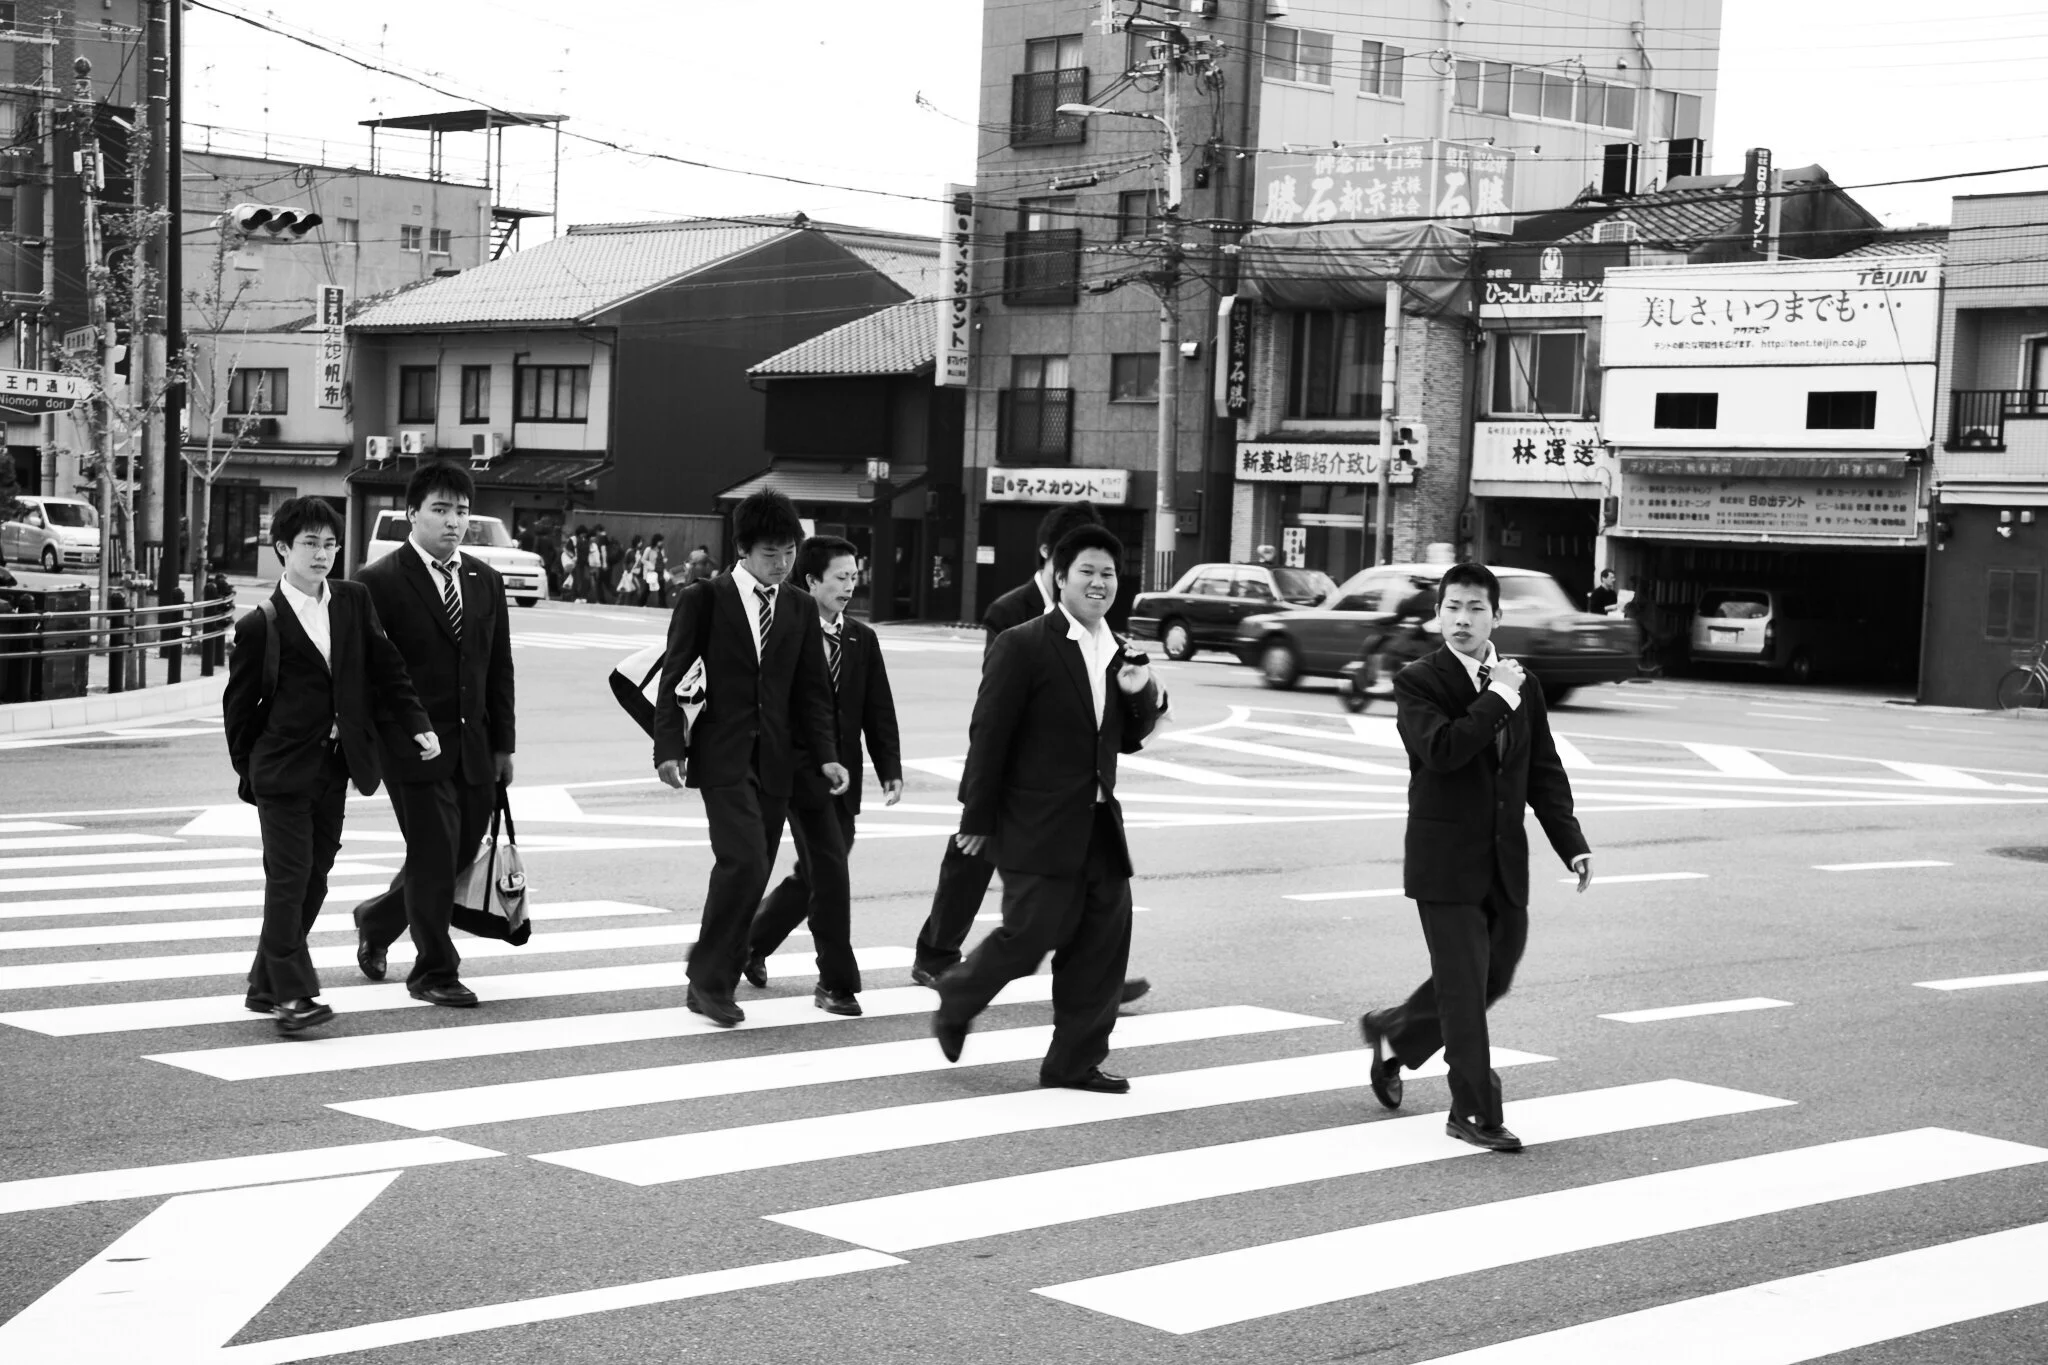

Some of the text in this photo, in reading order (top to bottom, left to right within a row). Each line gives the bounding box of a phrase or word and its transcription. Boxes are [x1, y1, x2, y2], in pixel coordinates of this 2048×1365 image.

[1857, 270, 1928, 288] TEIJIN
[324, 363, 341, 405] 帆布
[45, 398, 67, 409] dori
[1243, 449, 1403, 476] 新墓地御紹介致しす
[1512, 438, 1595, 467] 林運送
[1749, 495, 1806, 508] 日の出テント
